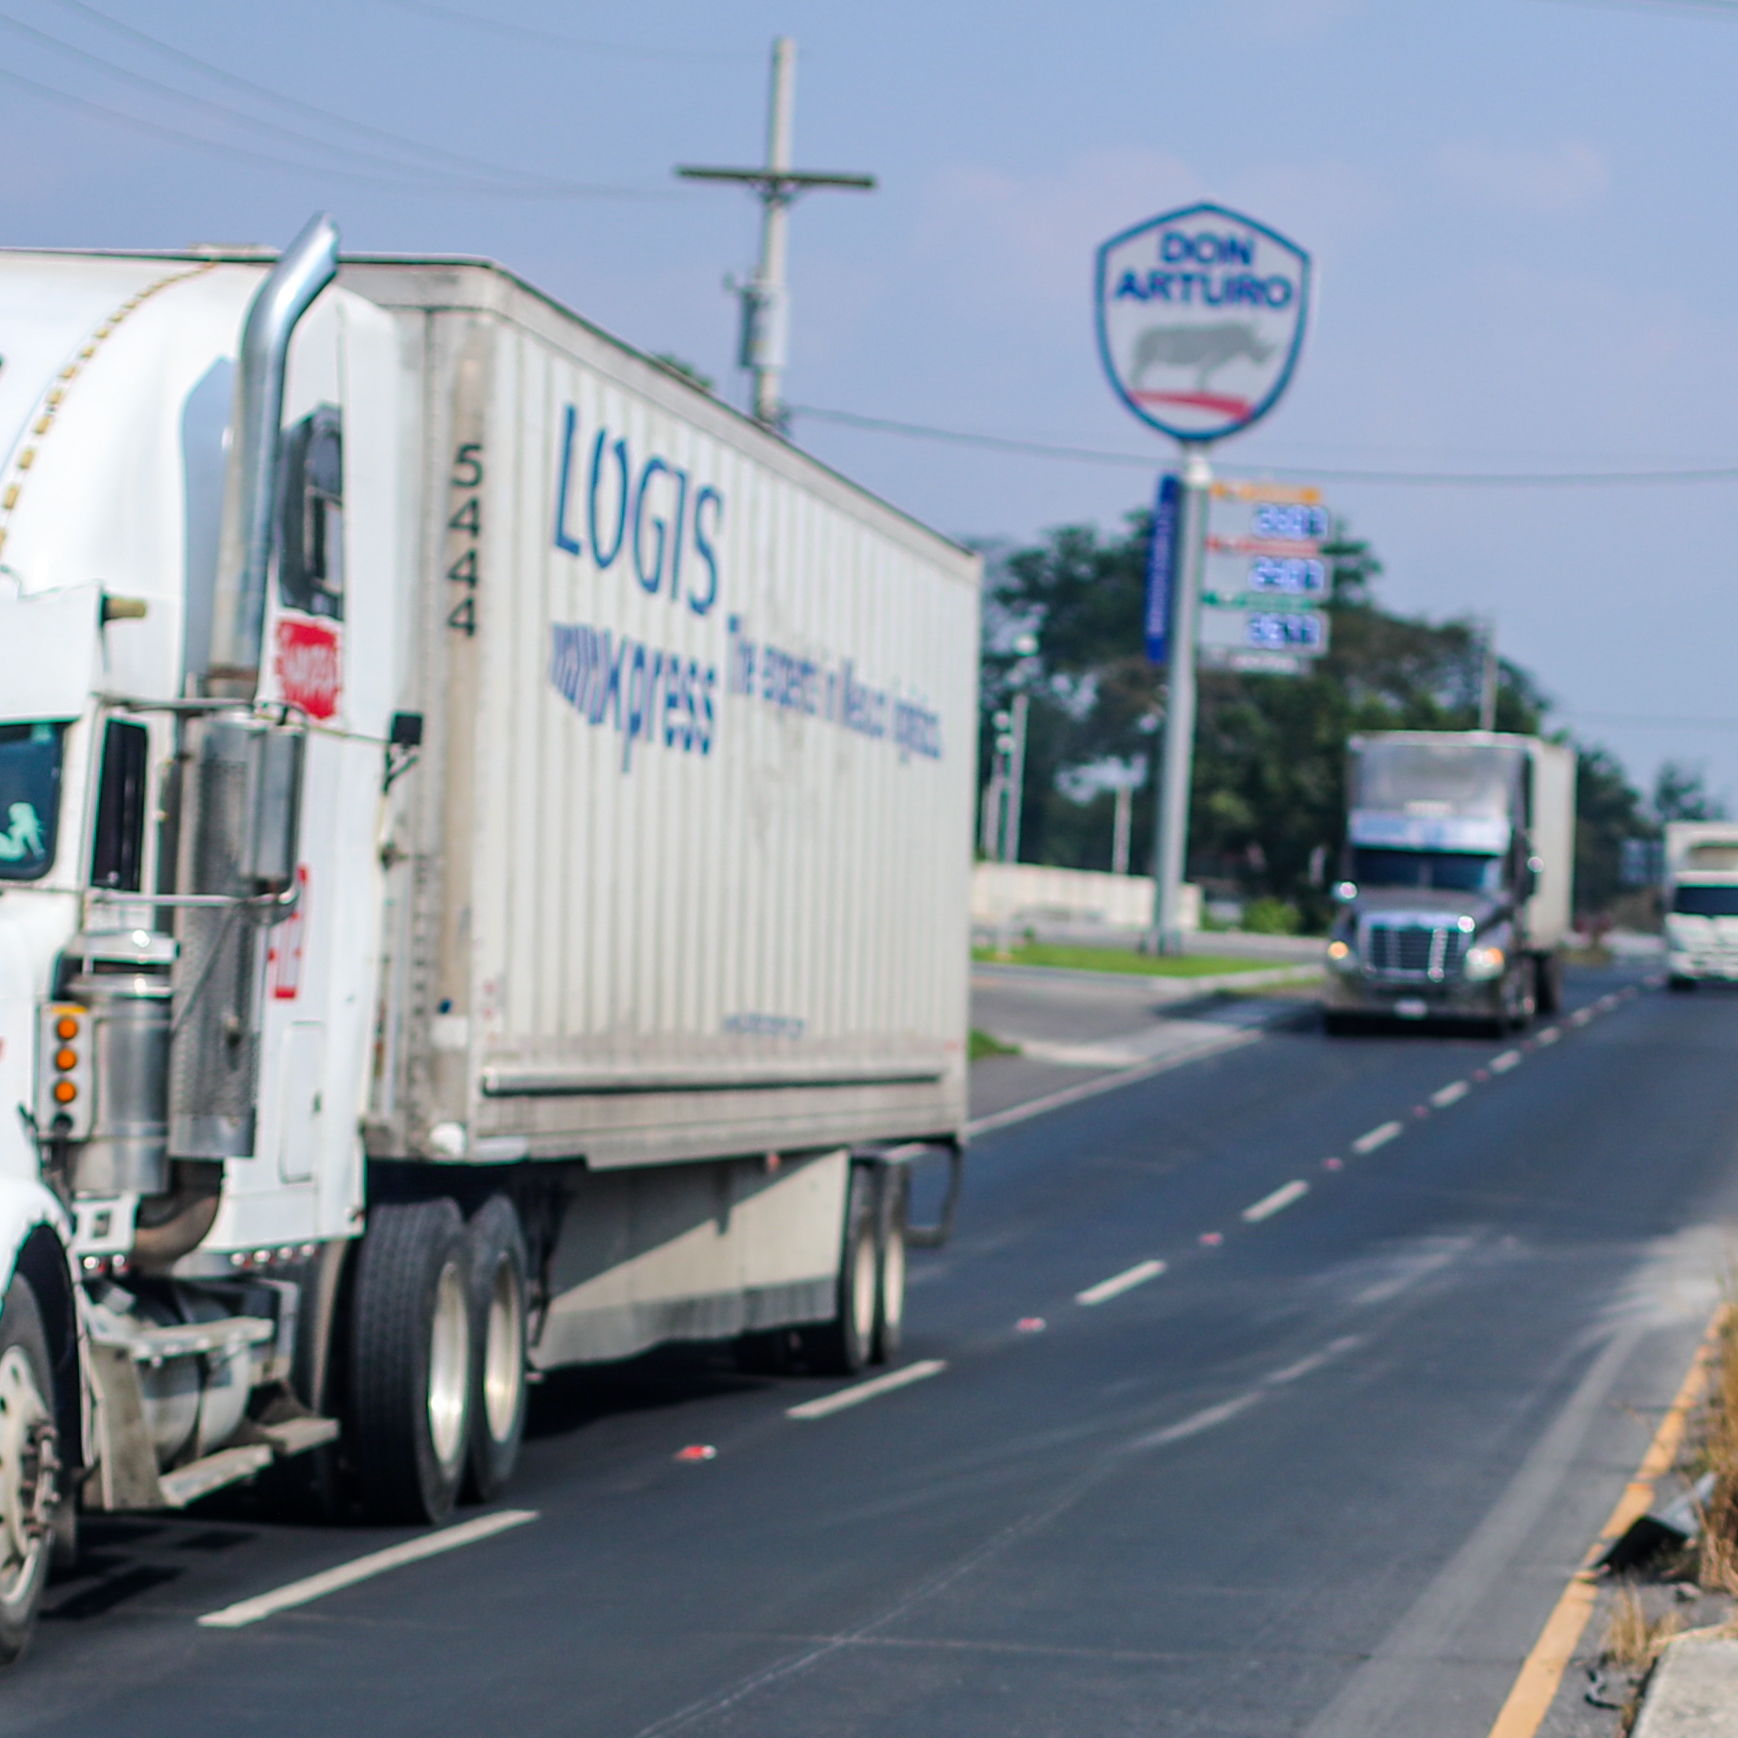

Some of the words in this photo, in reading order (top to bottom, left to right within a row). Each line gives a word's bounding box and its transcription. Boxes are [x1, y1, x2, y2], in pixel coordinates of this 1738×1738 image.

[1116, 271, 1293, 309] ARTURO
[1164, 231, 1252, 265] DON
[447, 444, 483, 638] 5444
[552, 404, 723, 616] LOGIS
